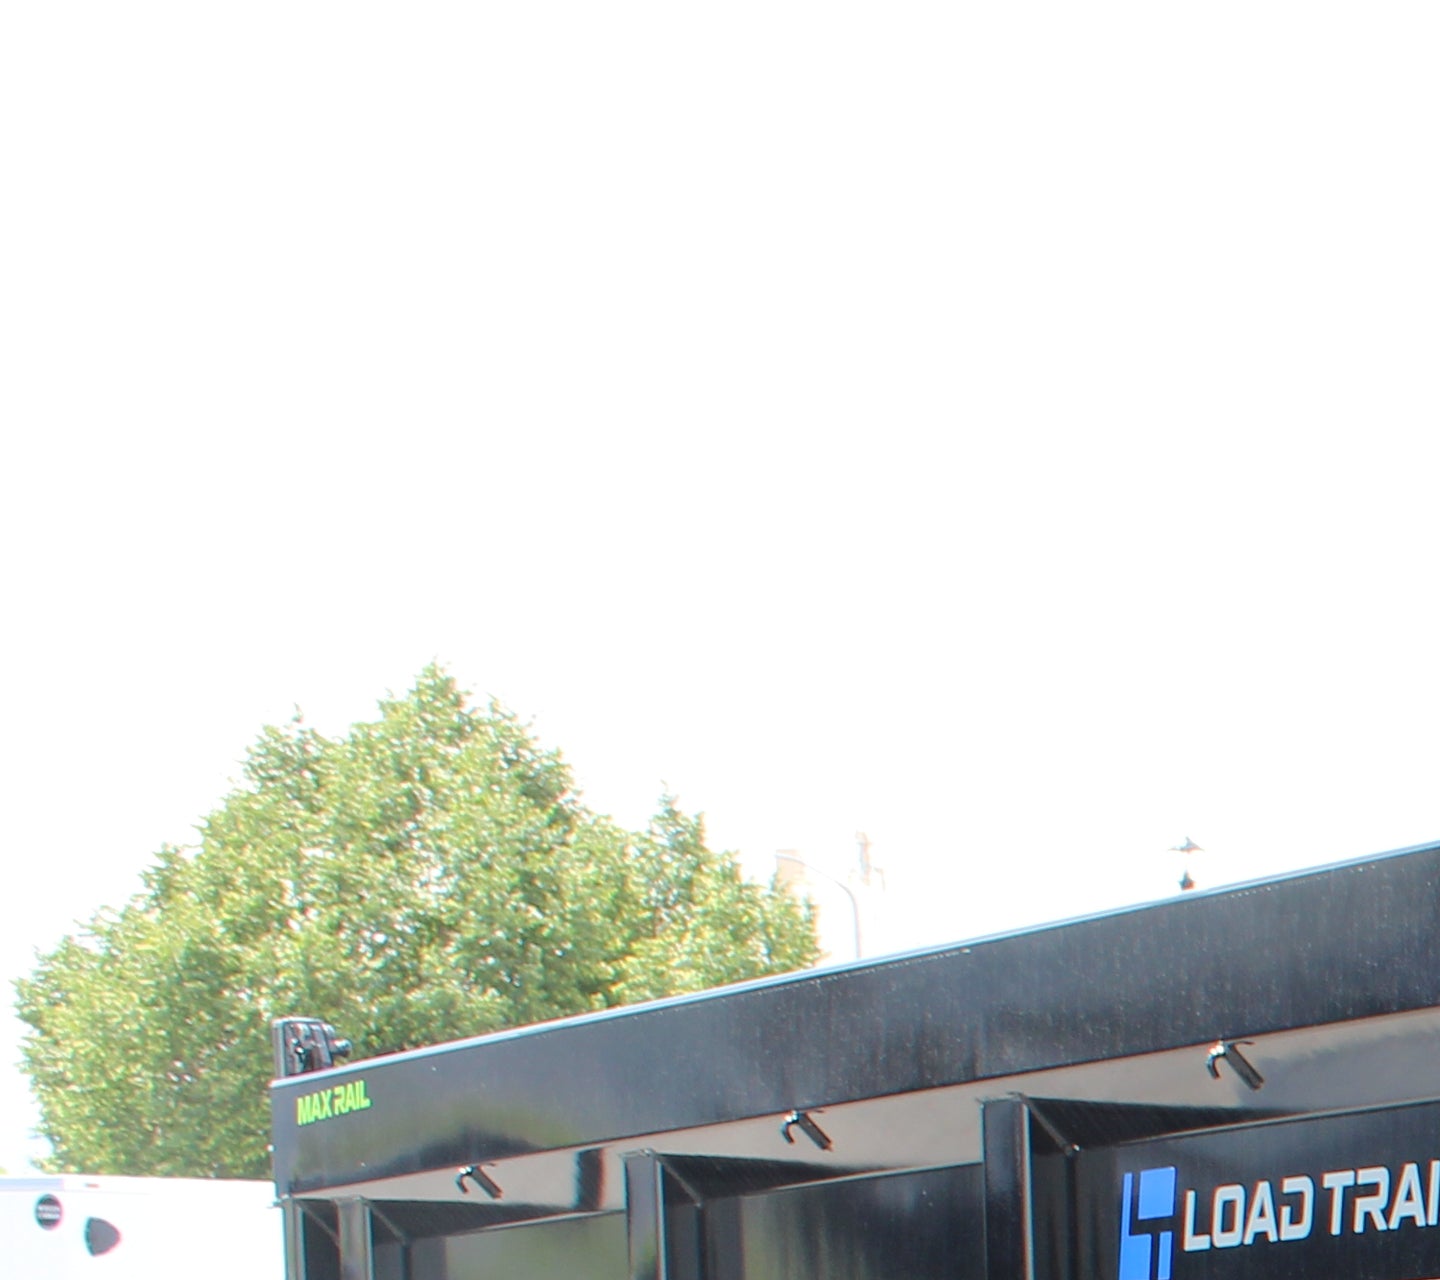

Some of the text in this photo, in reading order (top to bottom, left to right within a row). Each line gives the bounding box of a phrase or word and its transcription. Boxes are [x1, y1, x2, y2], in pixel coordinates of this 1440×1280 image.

[297, 1079, 372, 1126] MAX RAIL
[1182, 1174, 1313, 1253] LOAD
